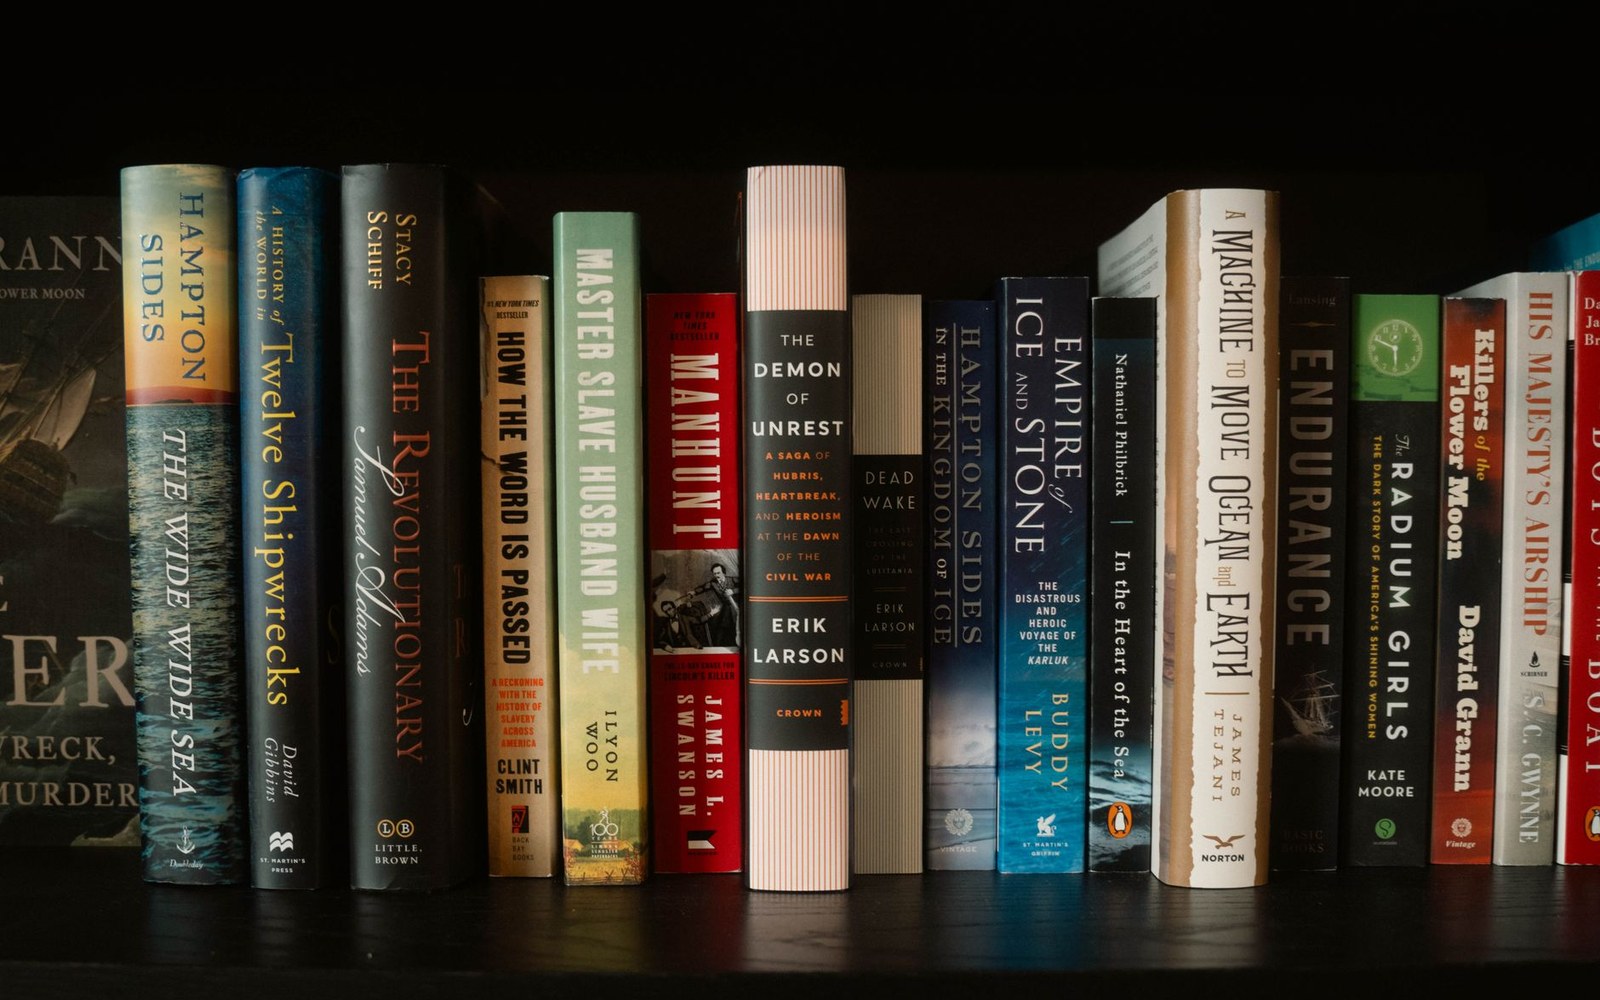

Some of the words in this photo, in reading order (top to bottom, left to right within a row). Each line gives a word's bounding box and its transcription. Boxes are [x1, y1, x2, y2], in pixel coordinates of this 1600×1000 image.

[1225, 209, 1246, 220] A
[256, 237, 268, 301] WORLD
[271, 226, 285, 303] HISTORY
[367, 210, 388, 290] SCHIFF
[395, 213, 417, 286] STACY
[42, 287, 86, 300] MOON
[140, 232, 165, 343] SIDES
[179, 192, 207, 382] HAMPTON
[576, 248, 614, 360] MASTER
[1212, 229, 1257, 353] MACHINE
[1288, 293, 1337, 307] Lansing
[269, 308, 285, 326] of
[496, 311, 529, 319] BESTSELLER
[935, 327, 947, 345] IN
[1014, 297, 1044, 358] ICE
[1527, 291, 1553, 340] HIS
[497, 331, 526, 387] HOW
[780, 335, 815, 347] THE
[391, 330, 430, 413] THE
[754, 362, 842, 378] DEMON
[935, 355, 947, 386] THE
[1015, 372, 1029, 410] AND
[1114, 353, 1128, 425] Nathaniel
[1226, 359, 1246, 379] TO
[1473, 328, 1495, 432] Killers
[259, 331, 297, 465] Twelve
[498, 394, 527, 442] THE
[577, 371, 616, 454] SLAVE
[786, 393, 810, 405] OF
[960, 325, 982, 512] HAMPTON
[1054, 337, 1082, 480] EMPIRE
[1449, 364, 1471, 471] Flower
[752, 420, 844, 436] UNREST
[1211, 384, 1250, 461] MOVE
[1373, 435, 1382, 458] THE
[1476, 434, 1491, 452] of
[1525, 352, 1553, 507] MAJESTY'S
[162, 428, 188, 502] THE
[670, 353, 722, 541] MANHUNT
[777, 452, 811, 460] SAGA
[815, 452, 831, 460] OF
[1114, 431, 1129, 497] Philbrick
[1476, 456, 1491, 481] the
[499, 451, 529, 525] WORD
[756, 491, 841, 501] HEARTBREAK,
[773, 472, 824, 481] HUBRIS,
[865, 471, 915, 485] DEAD
[934, 395, 952, 550] KINGDOM
[1014, 417, 1046, 553] STONE
[1372, 462, 1382, 495] DARK
[755, 512, 780, 520] AND
[786, 512, 841, 521] HEROISM
[863, 496, 917, 510] WAKE
[1204, 474, 1252, 561] OCEAN
[1286, 349, 1334, 647] ENDURANCE
[1372, 500, 1381, 540] STORY
[1446, 476, 1470, 560] Moon
[501, 534, 529, 560] IS
[578, 465, 618, 597] HUSBAND
[757, 533, 772, 541] AT
[776, 533, 799, 541] THE
[803, 532, 840, 541] DAWN
[1371, 544, 1381, 560] OF
[1388, 462, 1414, 609] RADIUM
[164, 511, 191, 610] WIDE
[766, 573, 799, 581] CIVIL
[804, 573, 832, 581] WAR
[777, 552, 794, 561] OF
[798, 552, 821, 561] THE
[935, 558, 947, 579] OF
[1114, 551, 1131, 572] In
[1213, 566, 1237, 588] and
[1523, 516, 1551, 636] AIRSHIP
[253, 479, 301, 706] Shipwrecks
[391, 429, 431, 764] REVOLUTIONARY
[876, 604, 904, 614] ERIK
[961, 530, 983, 645] SIDES
[1015, 594, 1081, 604] DISASTROUS
[1038, 582, 1058, 591] THE
[1114, 580, 1130, 611] the
[1370, 565, 1380, 632] AMERICA'S
[354, 553, 406, 679] Adams
[501, 569, 531, 664] PASSED
[771, 618, 827, 633] ERIK
[864, 621, 916, 632] LARSON
[934, 590, 952, 644] ICE
[1028, 619, 1067, 628] HEROIC
[1036, 607, 1058, 616] AND
[1205, 592, 1254, 678] EARTH
[581, 607, 620, 674] WIFE
[753, 648, 845, 663] LARSON
[1019, 631, 1061, 641] VOYAGE
[1063, 631, 1077, 641] OF
[1027, 655, 1070, 665] KARLUK
[1037, 643, 1058, 653] THE
[1114, 618, 1131, 675] Heart
[1456, 605, 1481, 692] David
[166, 622, 194, 719] WIDE
[498, 678, 544, 687] RECKONING
[706, 672, 735, 681] KILLER
[1368, 636, 1379, 688] SHINING
[1385, 630, 1411, 741] GIRLS
[496, 703, 529, 712] HISTORY
[531, 702, 542, 711] OF
[499, 690, 523, 699] WITH
[524, 690, 537, 699] THE
[777, 709, 823, 718] CROWN
[1114, 681, 1130, 704] of
[1367, 692, 1377, 740] WOMEN
[500, 715, 536, 723] SLAVERY
[502, 727, 534, 735] ACROSS
[704, 695, 724, 780] JAMES
[1024, 709, 1043, 775] LEVY
[1051, 692, 1069, 792] BUDDY
[1113, 708, 1130, 738] the
[169, 729, 197, 797] SEA
[497, 759, 540, 775] CLINT
[501, 739, 537, 748] AMERICA
[586, 721, 599, 772] WOO
[605, 710, 618, 782] ILYON
[677, 694, 697, 816] SWANSON
[1113, 746, 1130, 779] Sea
[1212, 708, 1225, 803] TEJANI
[1230, 713, 1243, 797] JAMES
[1453, 696, 1479, 793] Grann
[263, 736, 280, 804] Gibbins
[281, 743, 299, 798] David
[495, 779, 543, 794] SMITH
[1358, 786, 1415, 798] MOORE
[1367, 769, 1406, 781] KATE
[1518, 752, 1542, 844] GWYNNE
[375, 856, 419, 865] BROWN
[1201, 854, 1245, 863] NORTON
[1445, 840, 1476, 849] Vintage
